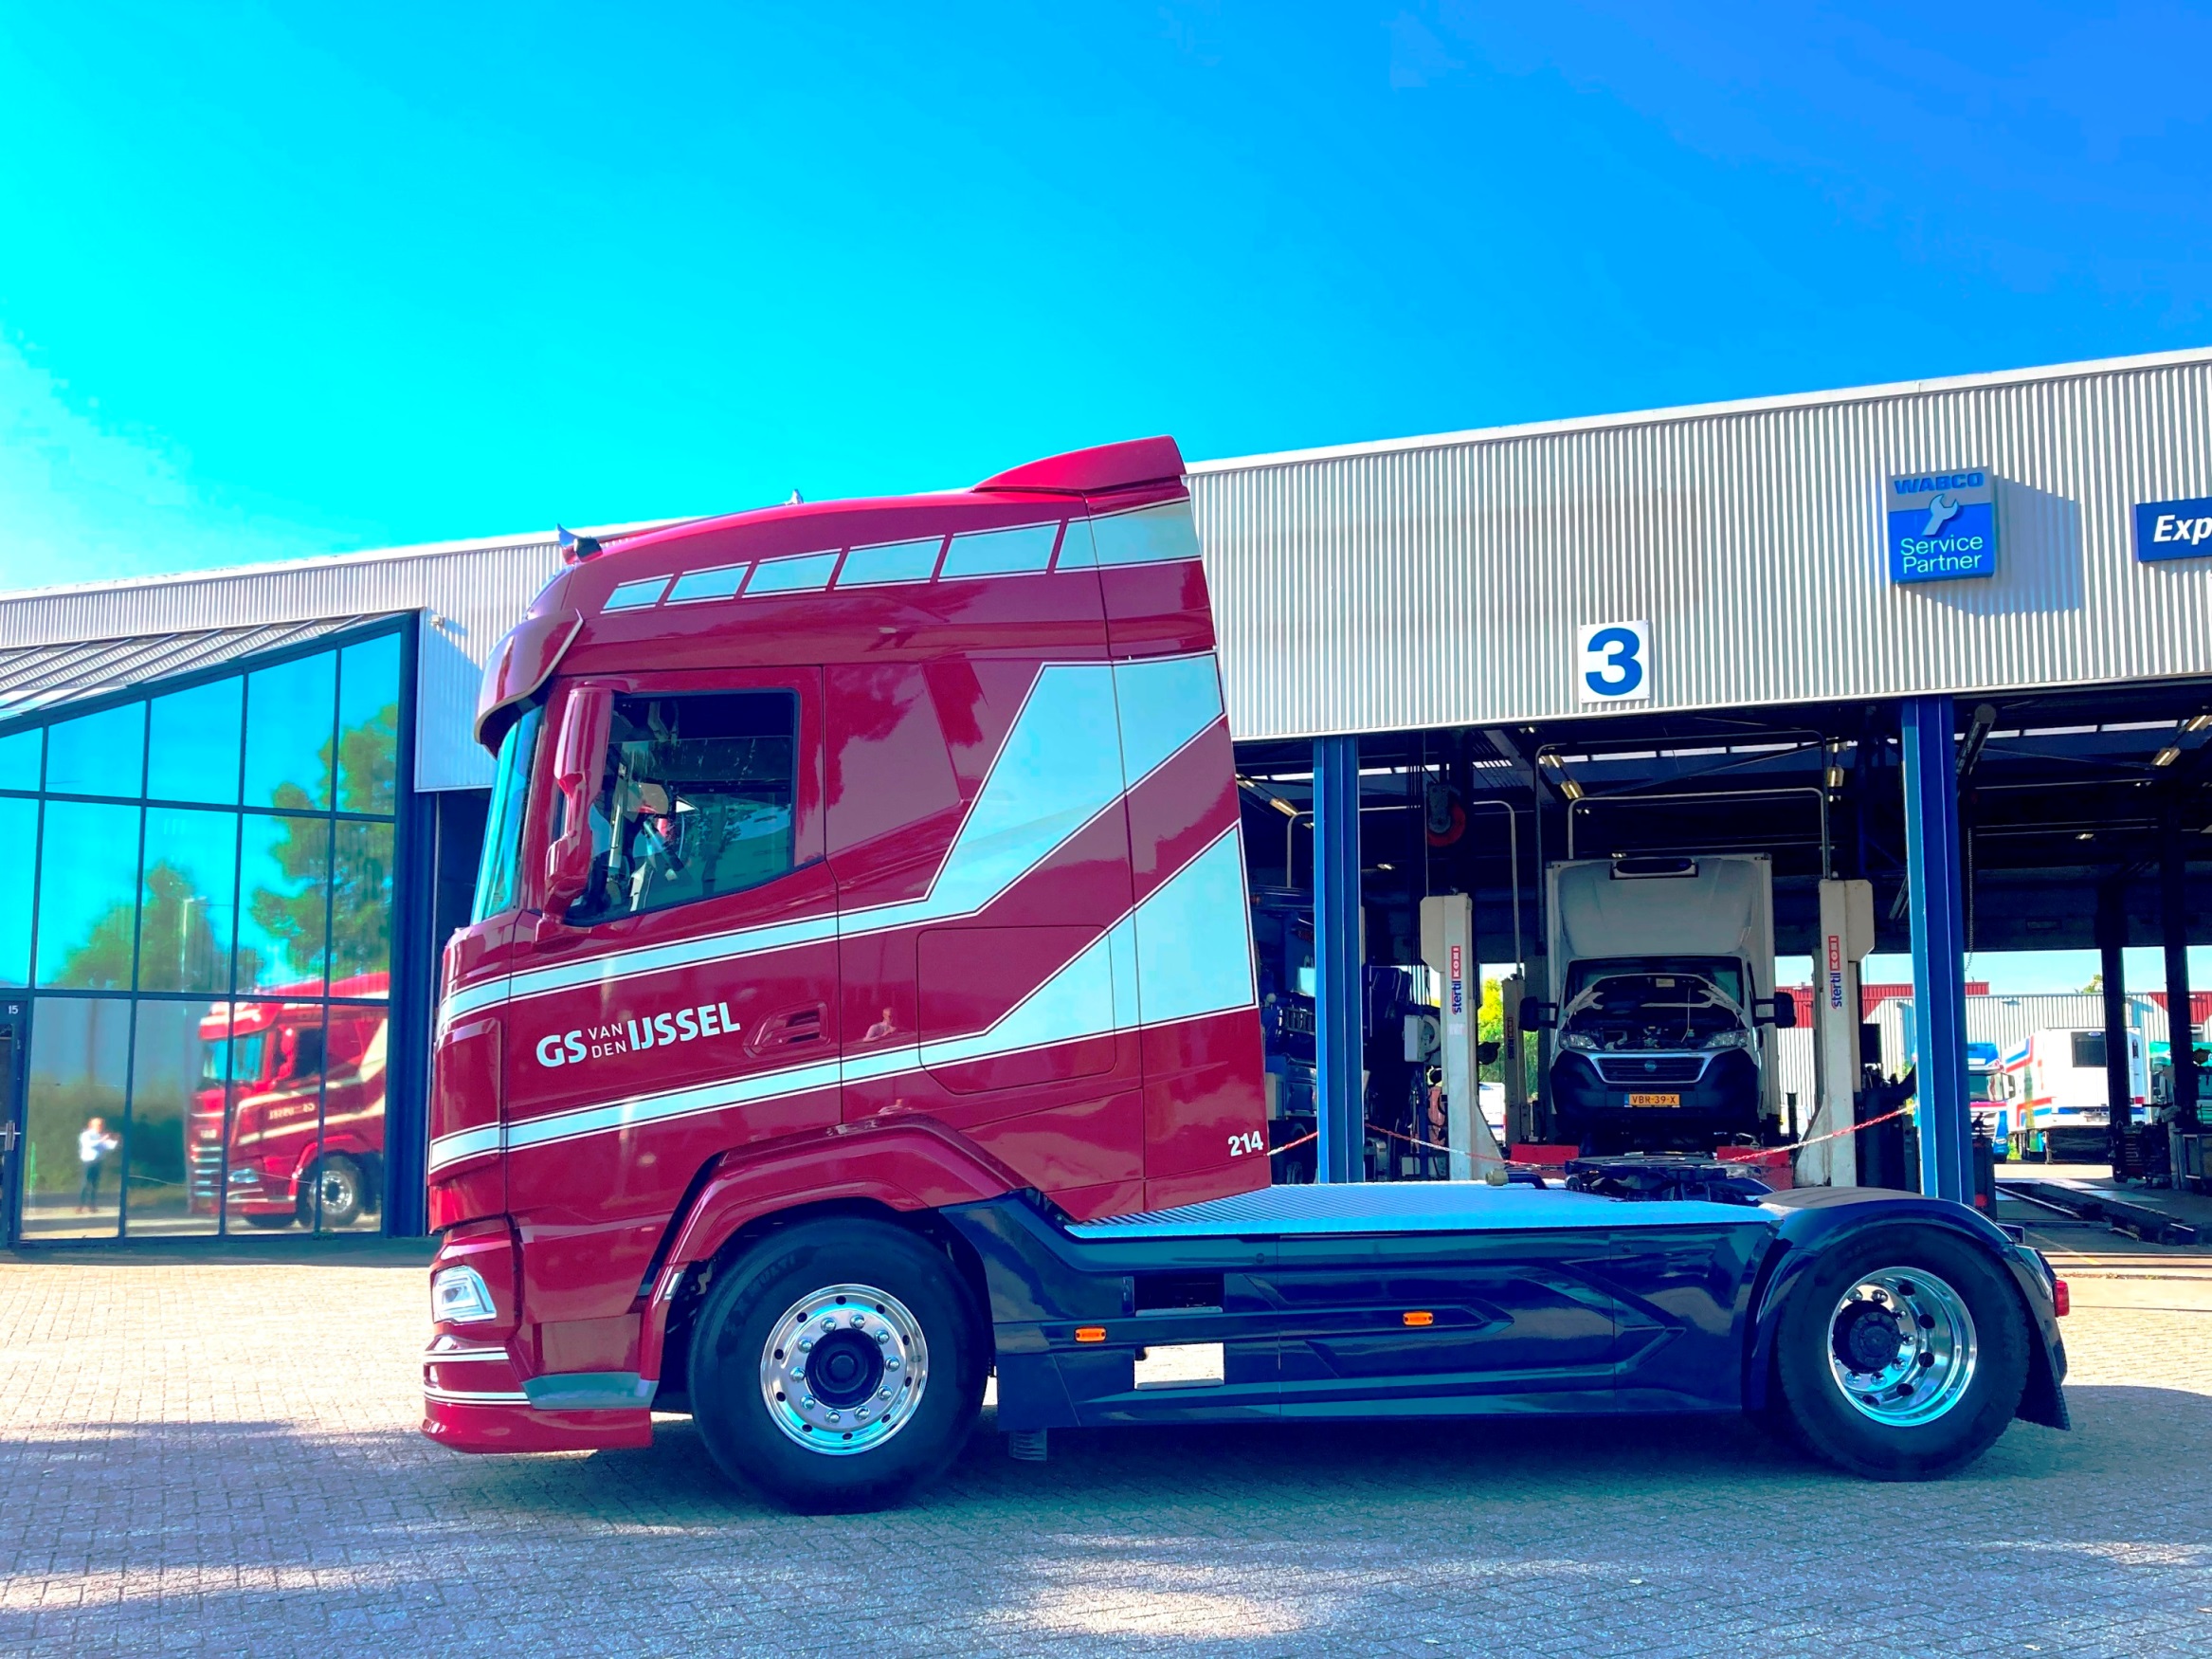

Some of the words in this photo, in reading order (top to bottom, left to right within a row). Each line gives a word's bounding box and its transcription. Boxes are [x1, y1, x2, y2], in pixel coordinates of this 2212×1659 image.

[1894, 472, 1985, 494] WABCO
[2153, 515, 2212, 546] Exp
[1900, 534, 1984, 556] Service
[1903, 555, 1983, 574] Partner
[1586, 627, 1643, 697] 3
[1451, 980, 1461, 1015] stertil
[1830, 973, 1842, 1010] stertil
[9, 1005, 19, 1014] 15
[535, 1030, 588, 1067] GS
[588, 1022, 624, 1041] VAN
[627, 1002, 741, 1051] IJSSEL
[591, 1040, 627, 1059] DEN
[1227, 1130, 1264, 1157] 214
